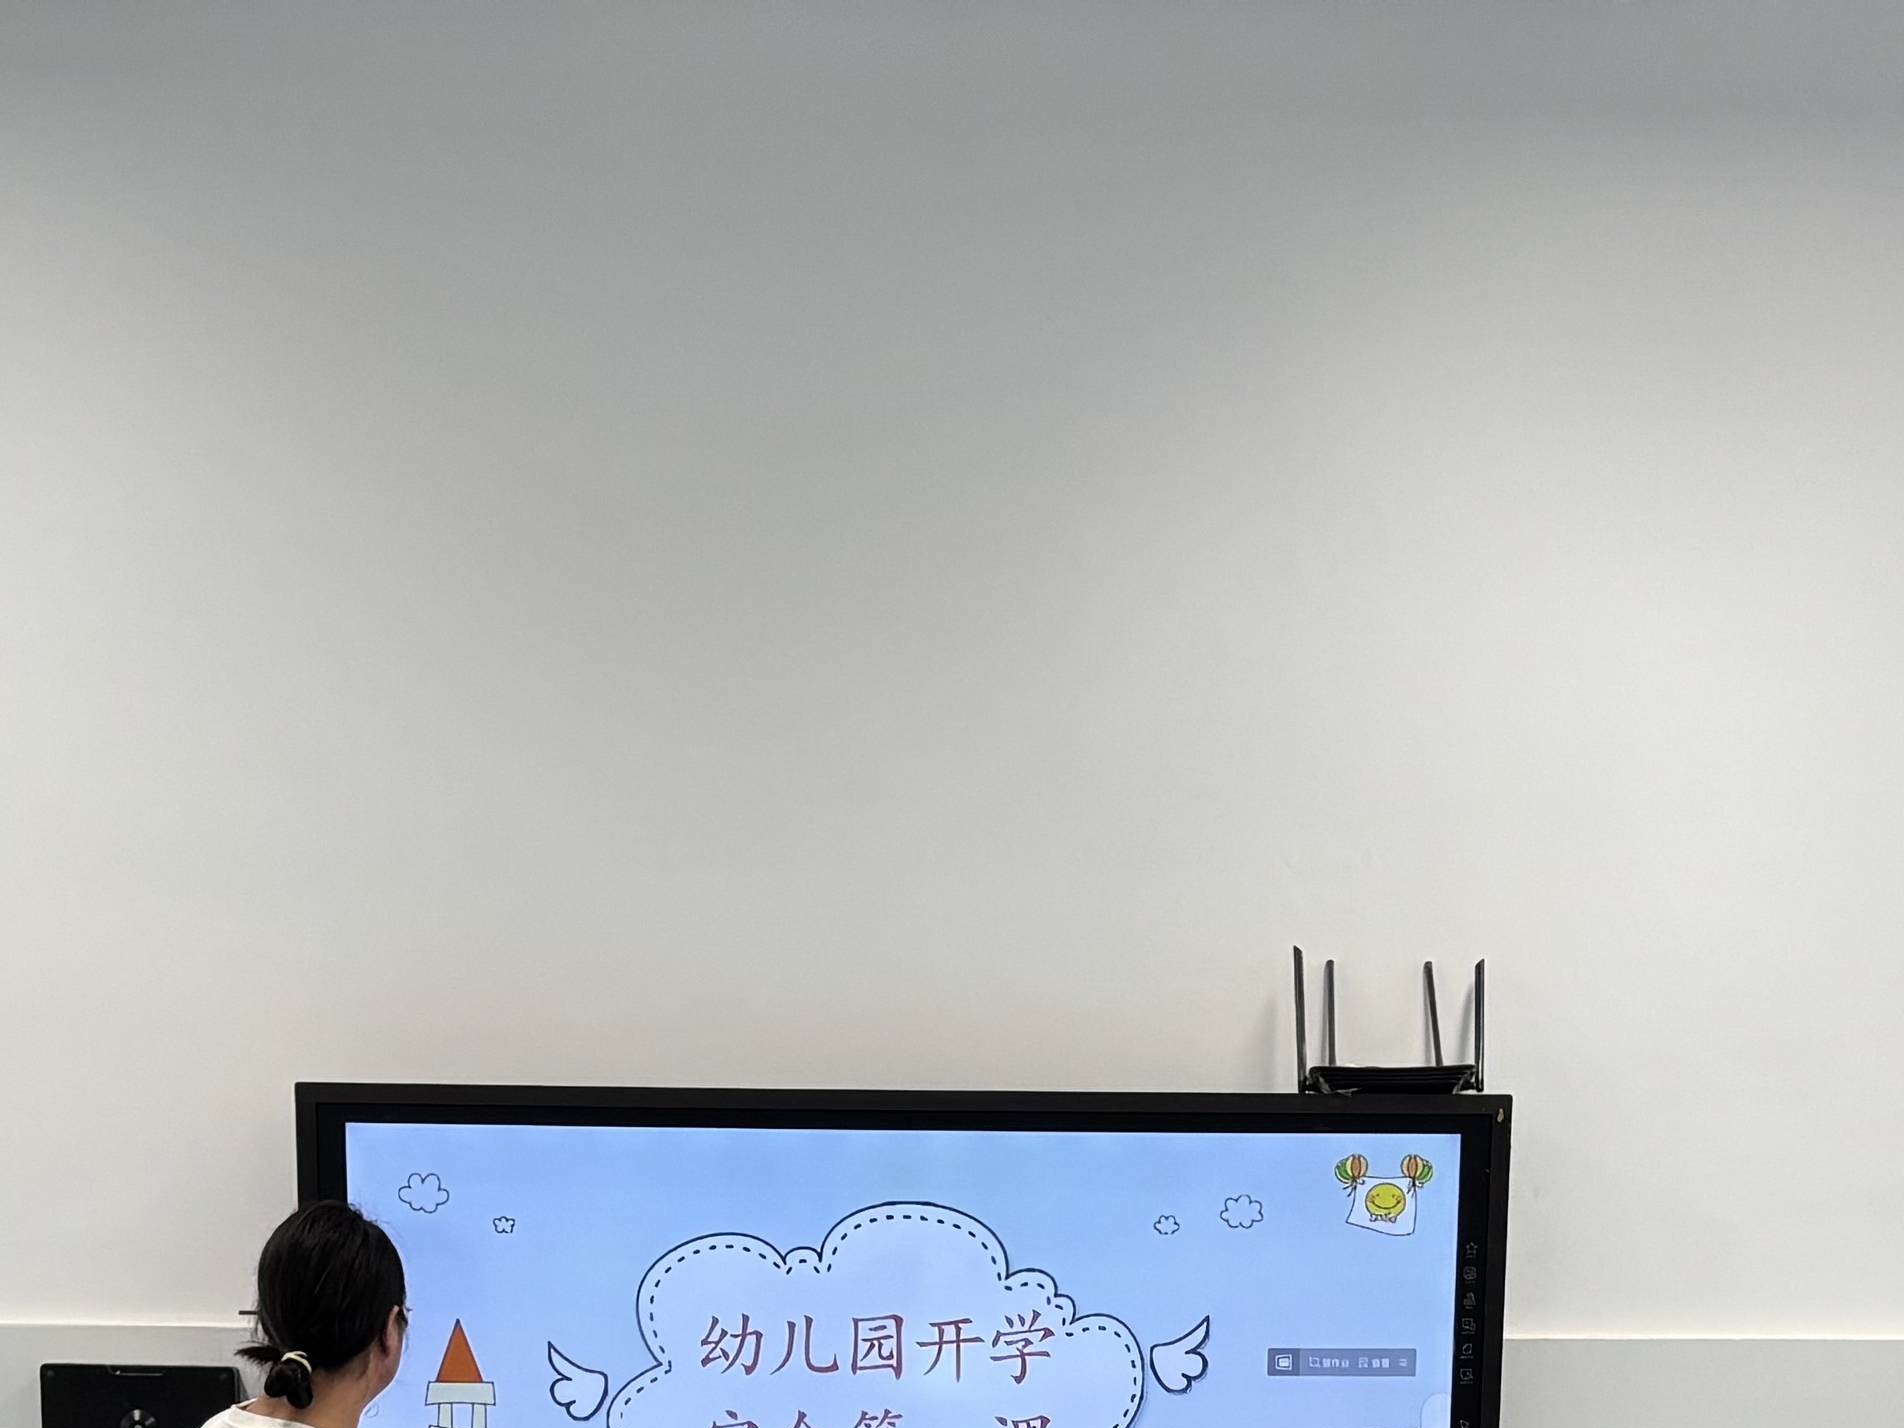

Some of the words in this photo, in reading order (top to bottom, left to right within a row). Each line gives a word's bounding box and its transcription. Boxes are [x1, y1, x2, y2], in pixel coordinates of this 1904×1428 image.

[700, 1308, 1057, 1386] 幼儿园开学
